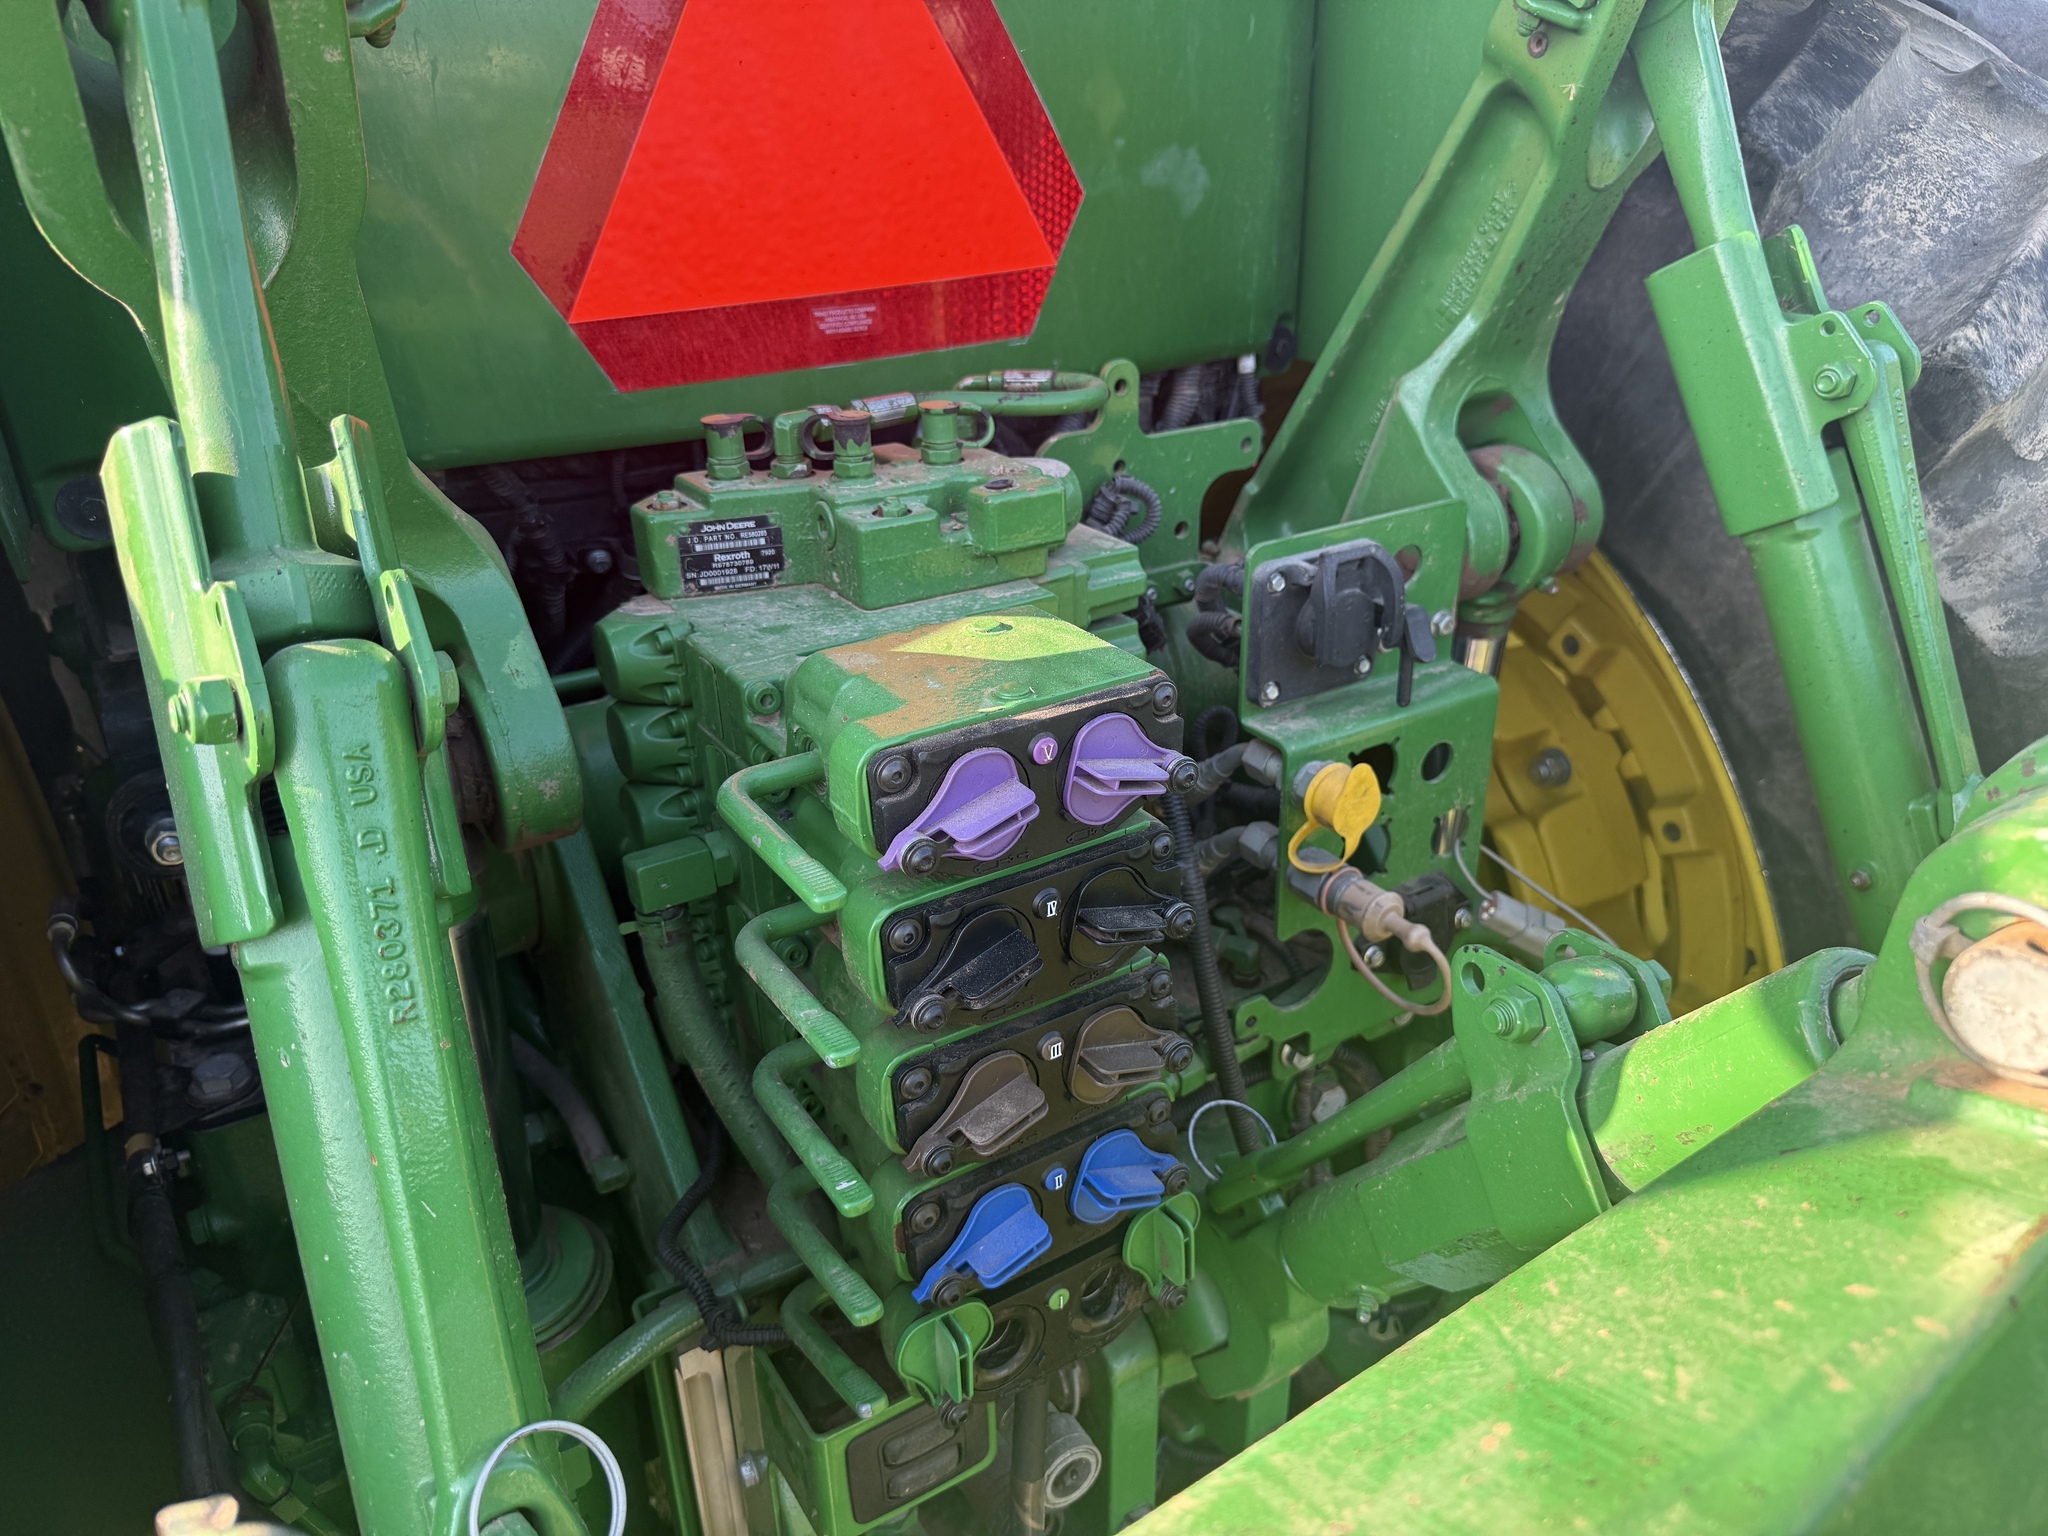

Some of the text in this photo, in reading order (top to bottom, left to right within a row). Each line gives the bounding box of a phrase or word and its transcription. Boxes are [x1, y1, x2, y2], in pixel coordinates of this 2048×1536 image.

[701, 521, 756, 533] JOHN DEERE
[704, 534, 722, 542] PART
[713, 550, 750, 562] Rexroth
[1041, 743, 1054, 761] V
[342, 743, 378, 807] USA
[366, 877, 419, 1025] R280371
[1050, 1042, 1062, 1060] III
[1054, 1174, 1063, 1190] II
